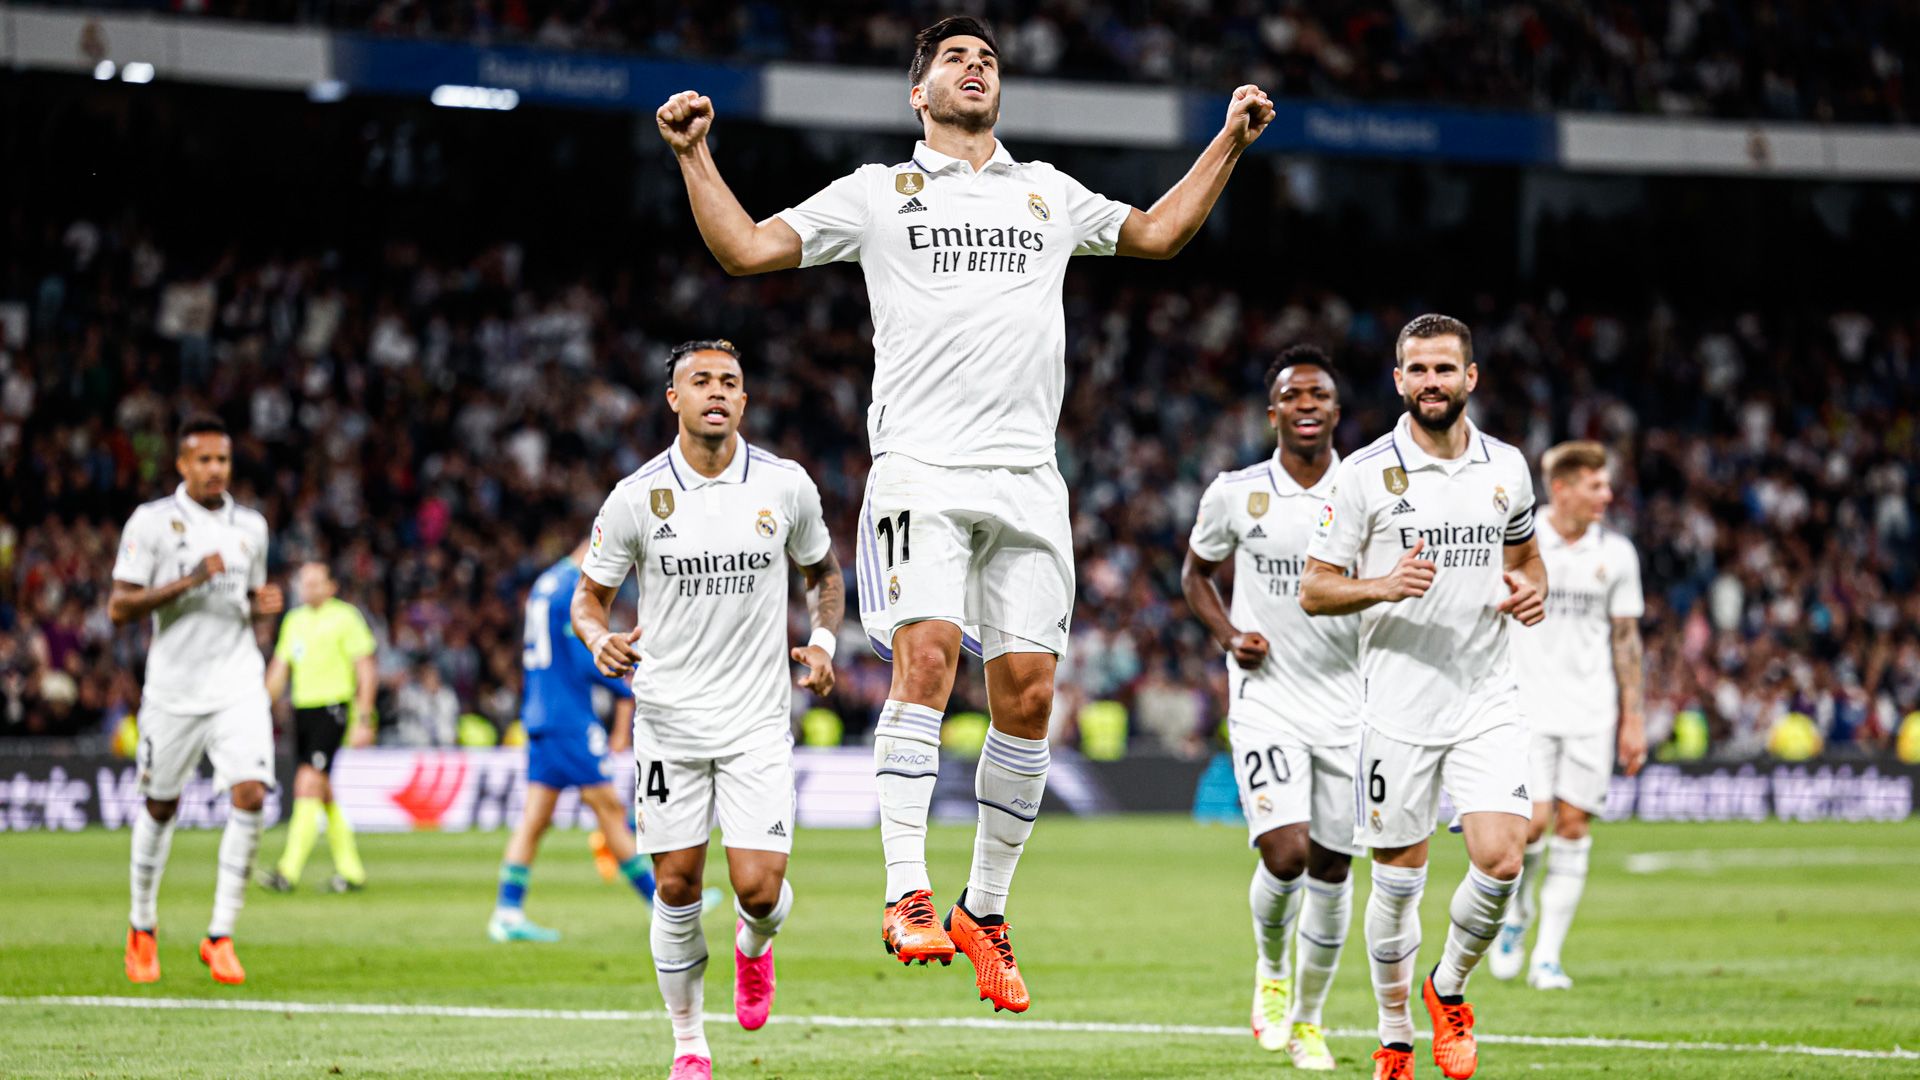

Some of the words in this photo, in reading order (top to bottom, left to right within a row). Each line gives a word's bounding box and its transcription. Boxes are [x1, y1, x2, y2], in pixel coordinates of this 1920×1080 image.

[898, 205, 927, 214] adidas
[906, 223, 1044, 252] Emirates
[933, 251, 960, 274] FLY
[967, 251, 1026, 274] BETTER
[876, 510, 910, 572] 11
[1399, 522, 1502, 549] Emirates
[659, 551, 772, 577] Emirates
[1443, 548, 1491, 567] BETTER
[678, 576, 701, 597] FLY
[706, 575, 755, 597] BETTER
[885, 753, 933, 766] RMCF
[1245, 744, 1291, 790] 20
[1369, 759, 1386, 804] 6
